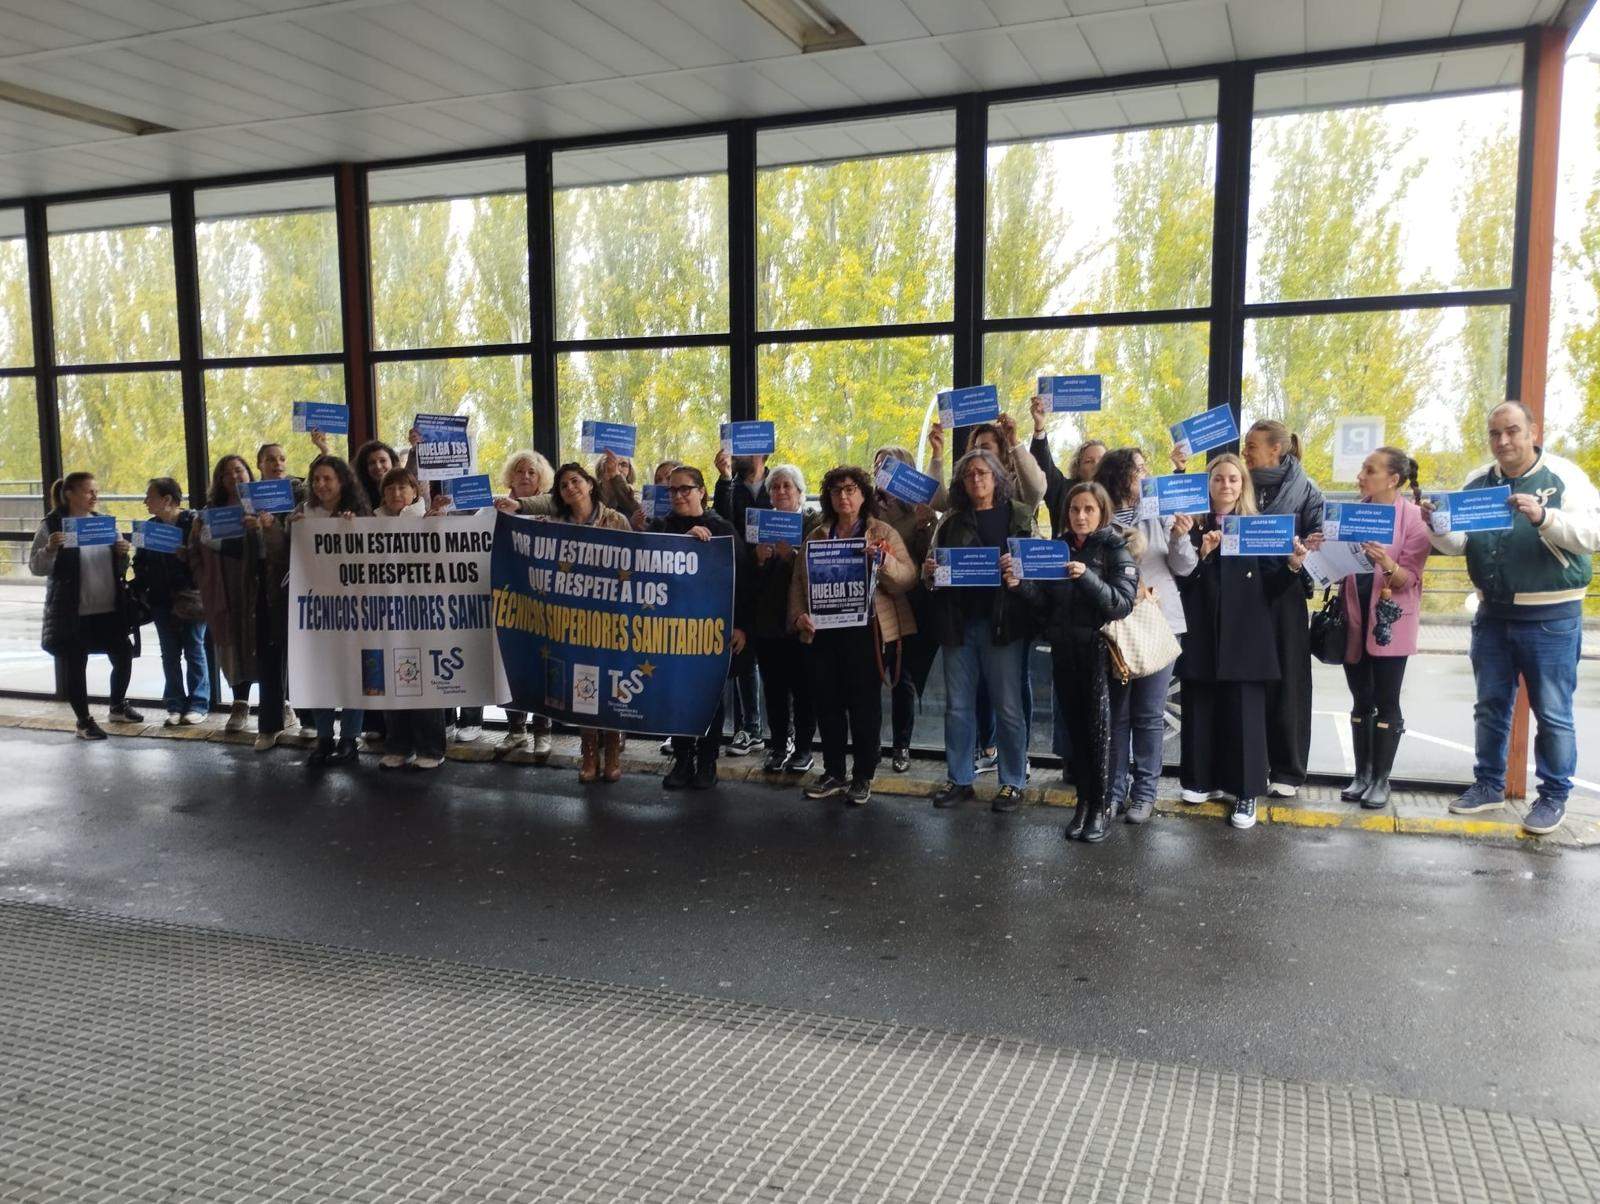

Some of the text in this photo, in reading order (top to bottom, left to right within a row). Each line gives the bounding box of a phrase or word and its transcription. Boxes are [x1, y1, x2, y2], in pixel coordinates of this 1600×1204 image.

[418, 440, 468, 457] HUELGA TSS
[315, 531, 492, 554] POR UN ESTATUTO MARC
[533, 536, 557, 561] UN
[559, 540, 631, 571] ESTATUTO
[635, 550, 699, 575] MARCO
[339, 562, 479, 586] QUE RESPETE A LOS
[528, 566, 668, 606] QUE RESPETE A LOS
[811, 581, 865, 600] HUELGA TSS
[297, 589, 491, 631] TÉCNICOS SUPERIORES SANIT
[492, 584, 725, 656] TÉCNICOS SUPERIORES SANITARIOS
